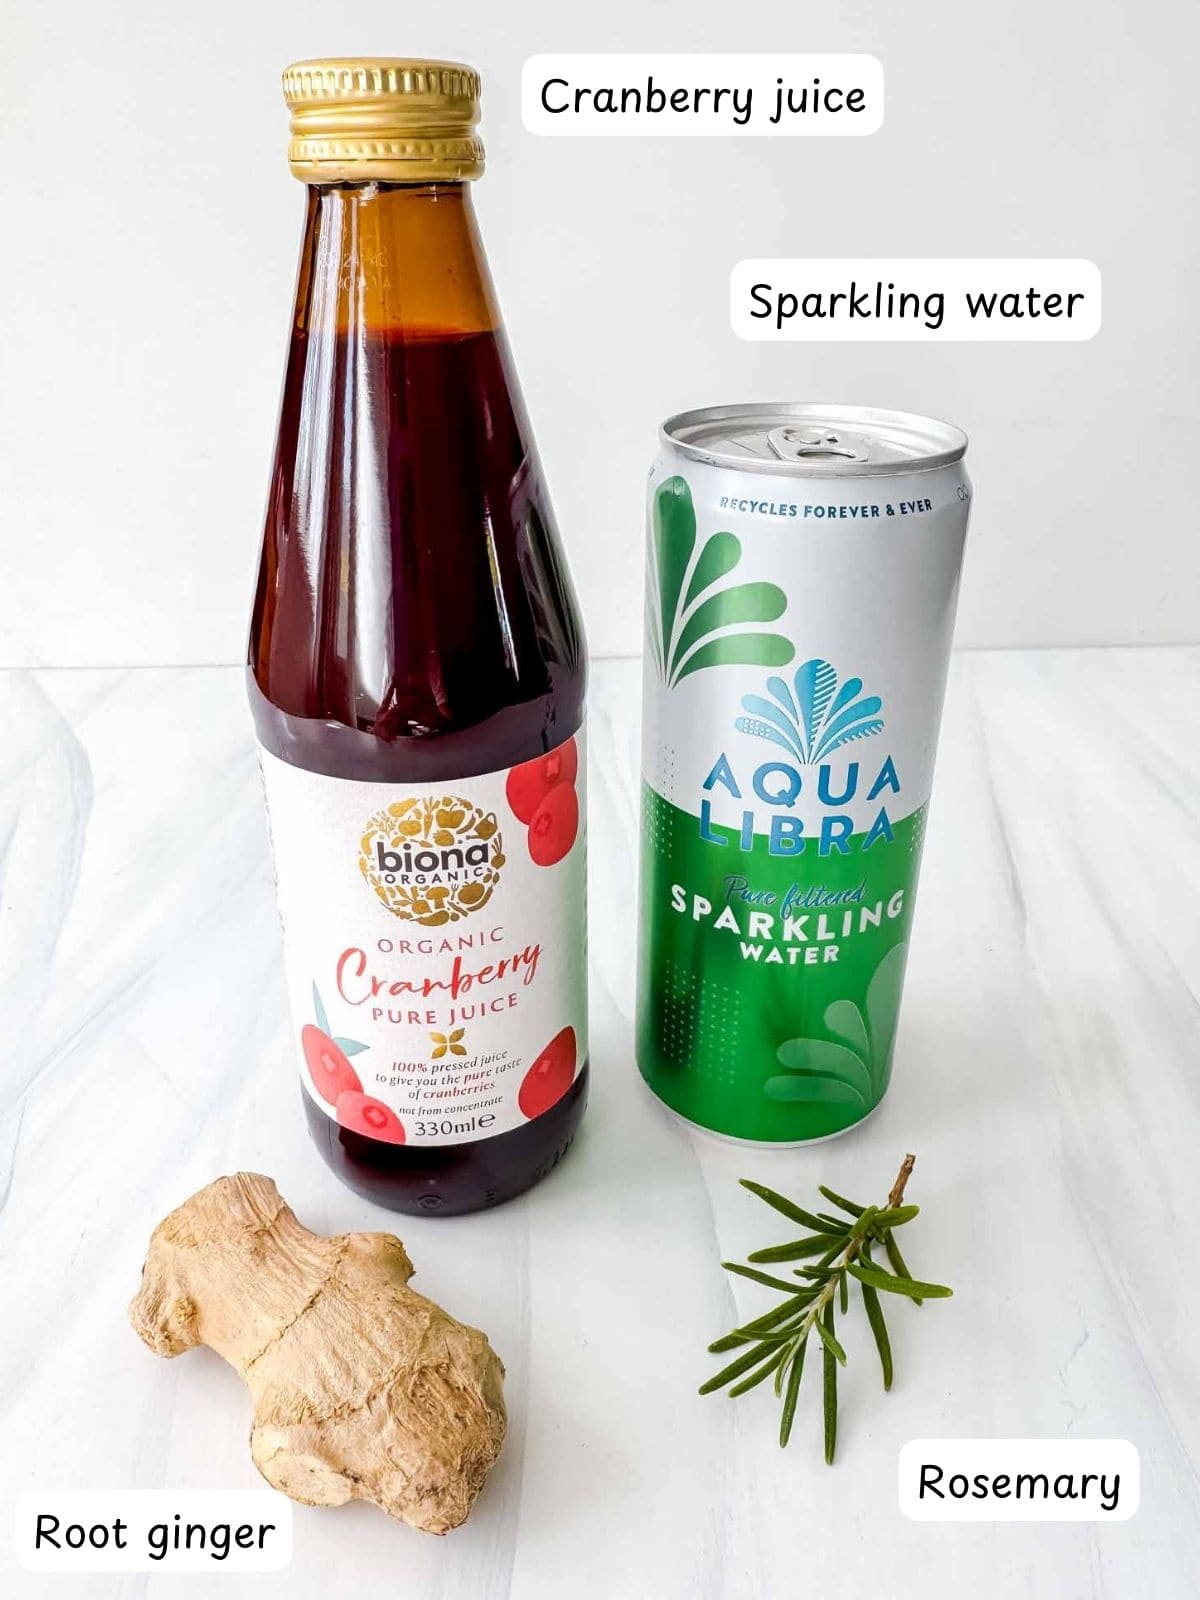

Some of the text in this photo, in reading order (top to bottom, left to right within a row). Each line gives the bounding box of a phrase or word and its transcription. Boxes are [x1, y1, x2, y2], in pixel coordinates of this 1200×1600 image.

[720, 496, 933, 519] RECYCLES FOREVER & EVER
[702, 752, 901, 808] AQUA
[700, 799, 895, 857] LIBRA
[377, 841, 489, 873] biona
[384, 867, 485, 885] ORGANIC
[722, 874, 867, 920] Pure filtered
[671, 884, 905, 942] SPARKLING
[378, 926, 505, 954] ORGANIC
[740, 941, 839, 965] WATER
[336, 942, 544, 1007] Cranberry
[372, 992, 519, 1026] PURE JUICE
[375, 1057, 522, 1088] to give you the pure taste
[392, 1050, 508, 1075] 100% pressed juice
[399, 1095, 504, 1117] not from concentrate
[408, 1081, 496, 1101] of cranberries
